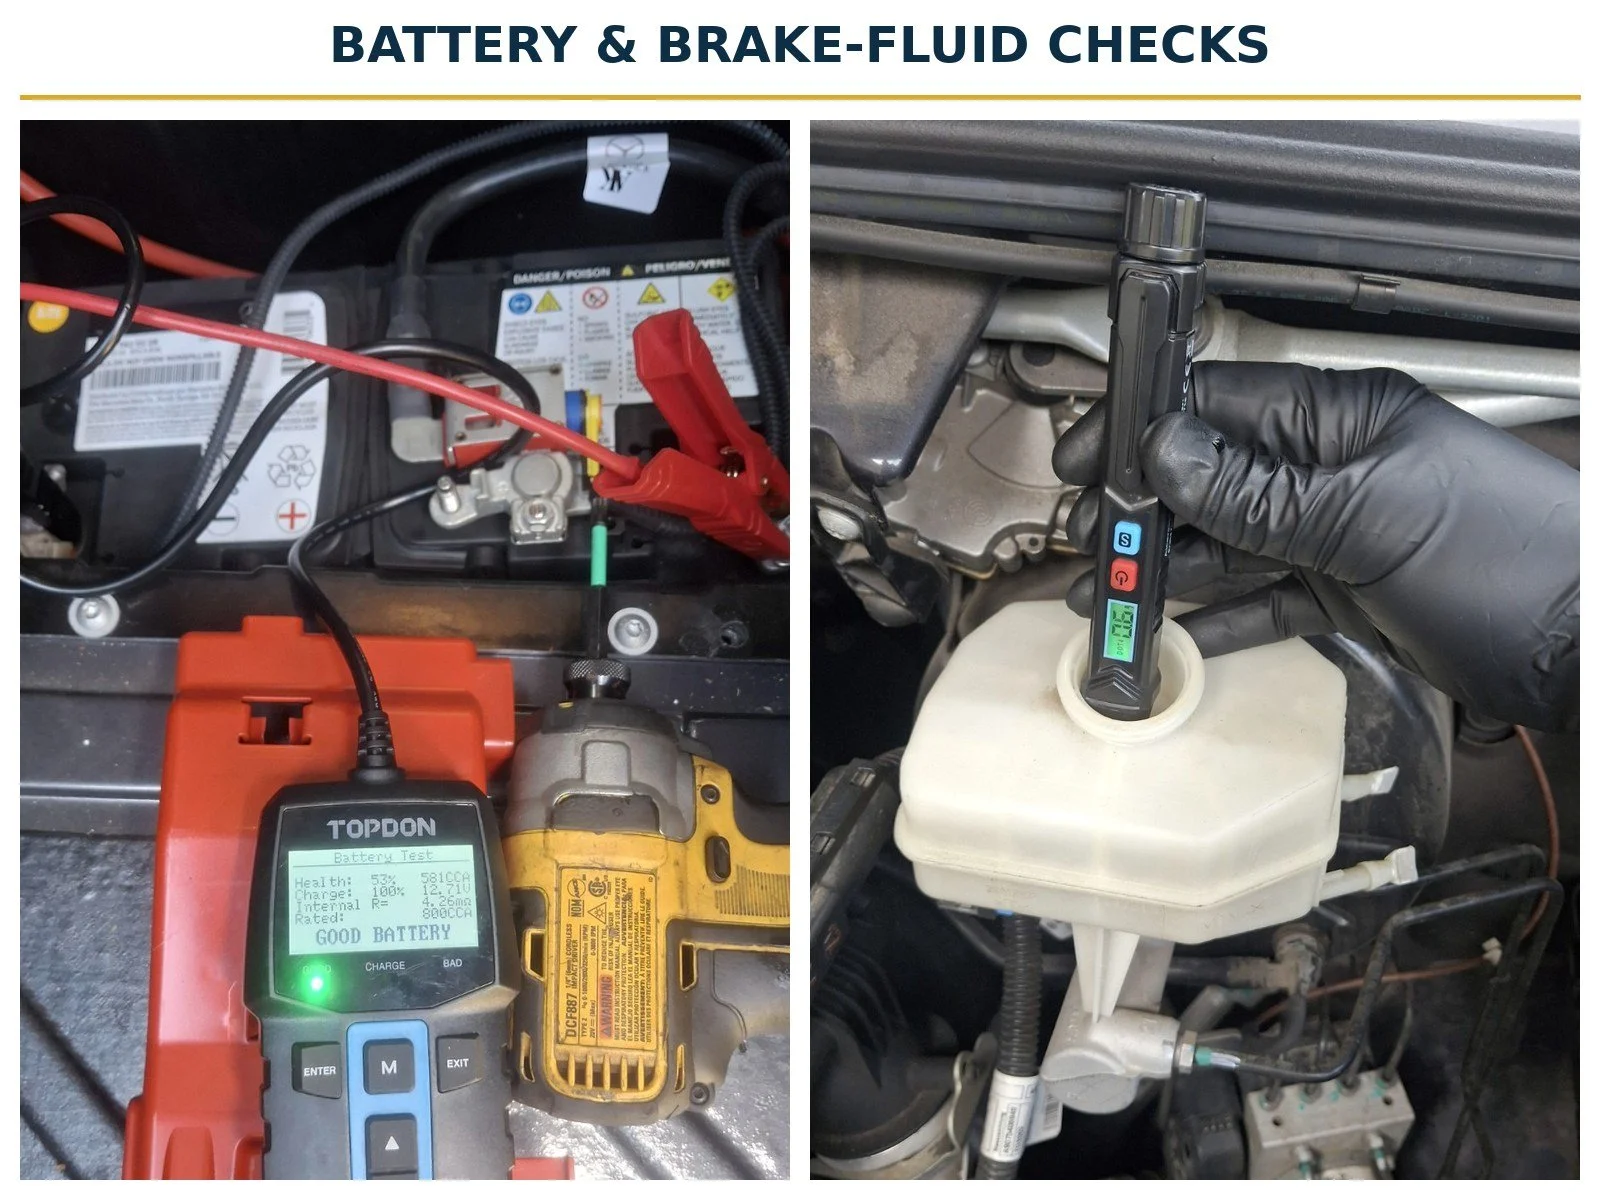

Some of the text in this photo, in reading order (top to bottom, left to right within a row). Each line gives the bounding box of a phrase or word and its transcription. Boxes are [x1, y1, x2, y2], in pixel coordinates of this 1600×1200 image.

[513, 267, 611, 284] DANGER/POISON
[326, 817, 437, 840] TOPDON
[333, 850, 434, 864] Battery Test
[295, 872, 471, 889] Health: 53% 581CCA
[295, 885, 471, 901] Charge: 100% 12.71V
[296, 899, 361, 913] Internal
[371, 899, 389, 910] R=
[571, 899, 581, 917] NOM
[294, 907, 473, 925] Rated: 800CCA
[315, 923, 452, 946] GOOD BATTERY
[365, 961, 406, 972] CHARGE
[443, 959, 463, 968] BAD
[601, 962, 607, 970] TO
[601, 976, 612, 1025] WARNING
[566, 993, 577, 1037] DCF887
[381, 1060, 397, 1075] M
[446, 1058, 469, 1068] EXIT
[303, 1066, 336, 1077] ENTER
